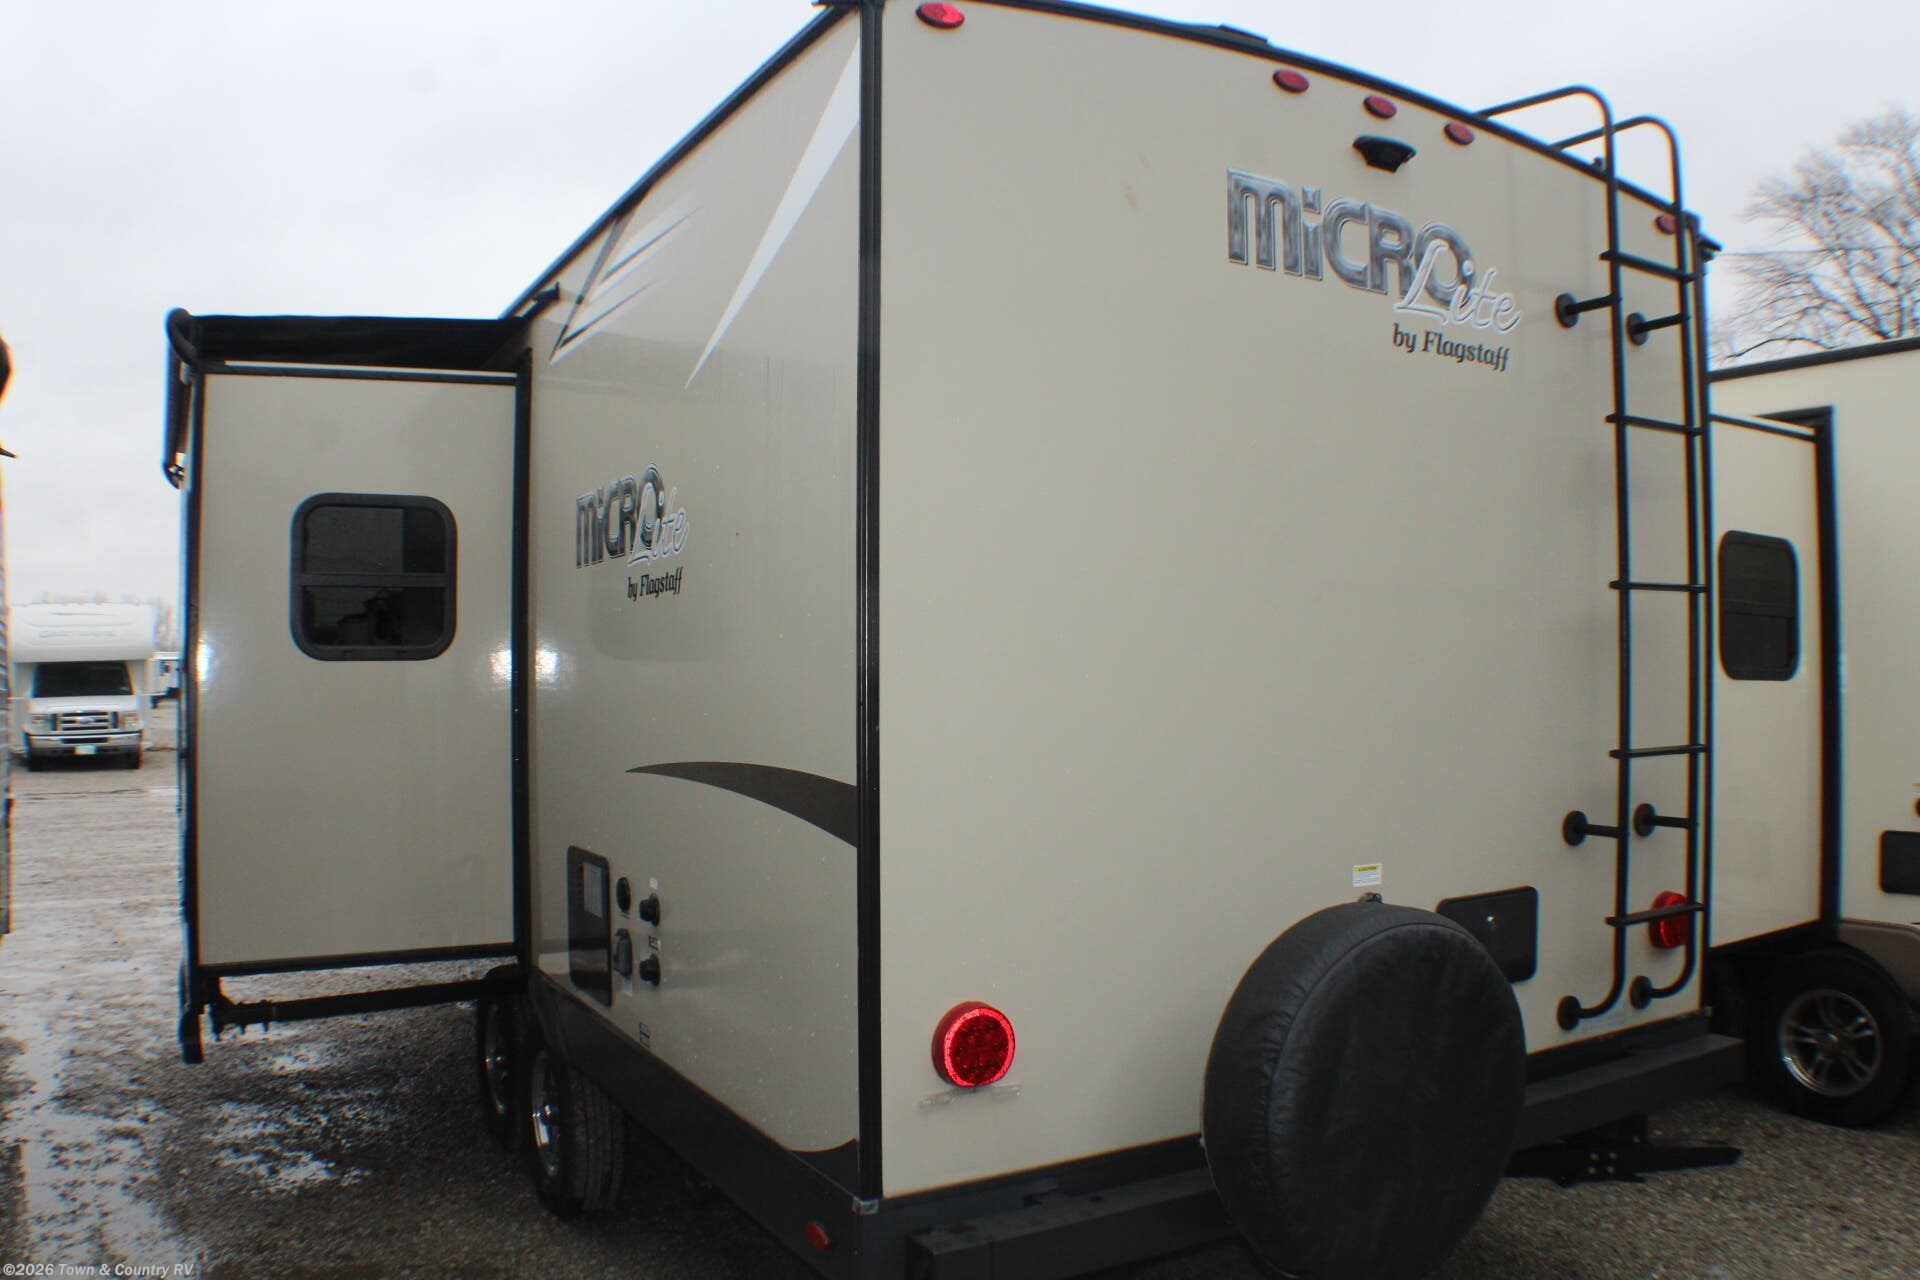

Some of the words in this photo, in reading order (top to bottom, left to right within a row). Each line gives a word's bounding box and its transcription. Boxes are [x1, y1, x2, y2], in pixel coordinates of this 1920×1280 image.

[1392, 239, 1521, 335] Lite
[1393, 322, 1417, 353] by
[1421, 330, 1510, 372] Flagstaff
[627, 482, 690, 567] Lite
[627, 577, 638, 602] by
[639, 566, 684, 599] Flagstaff
